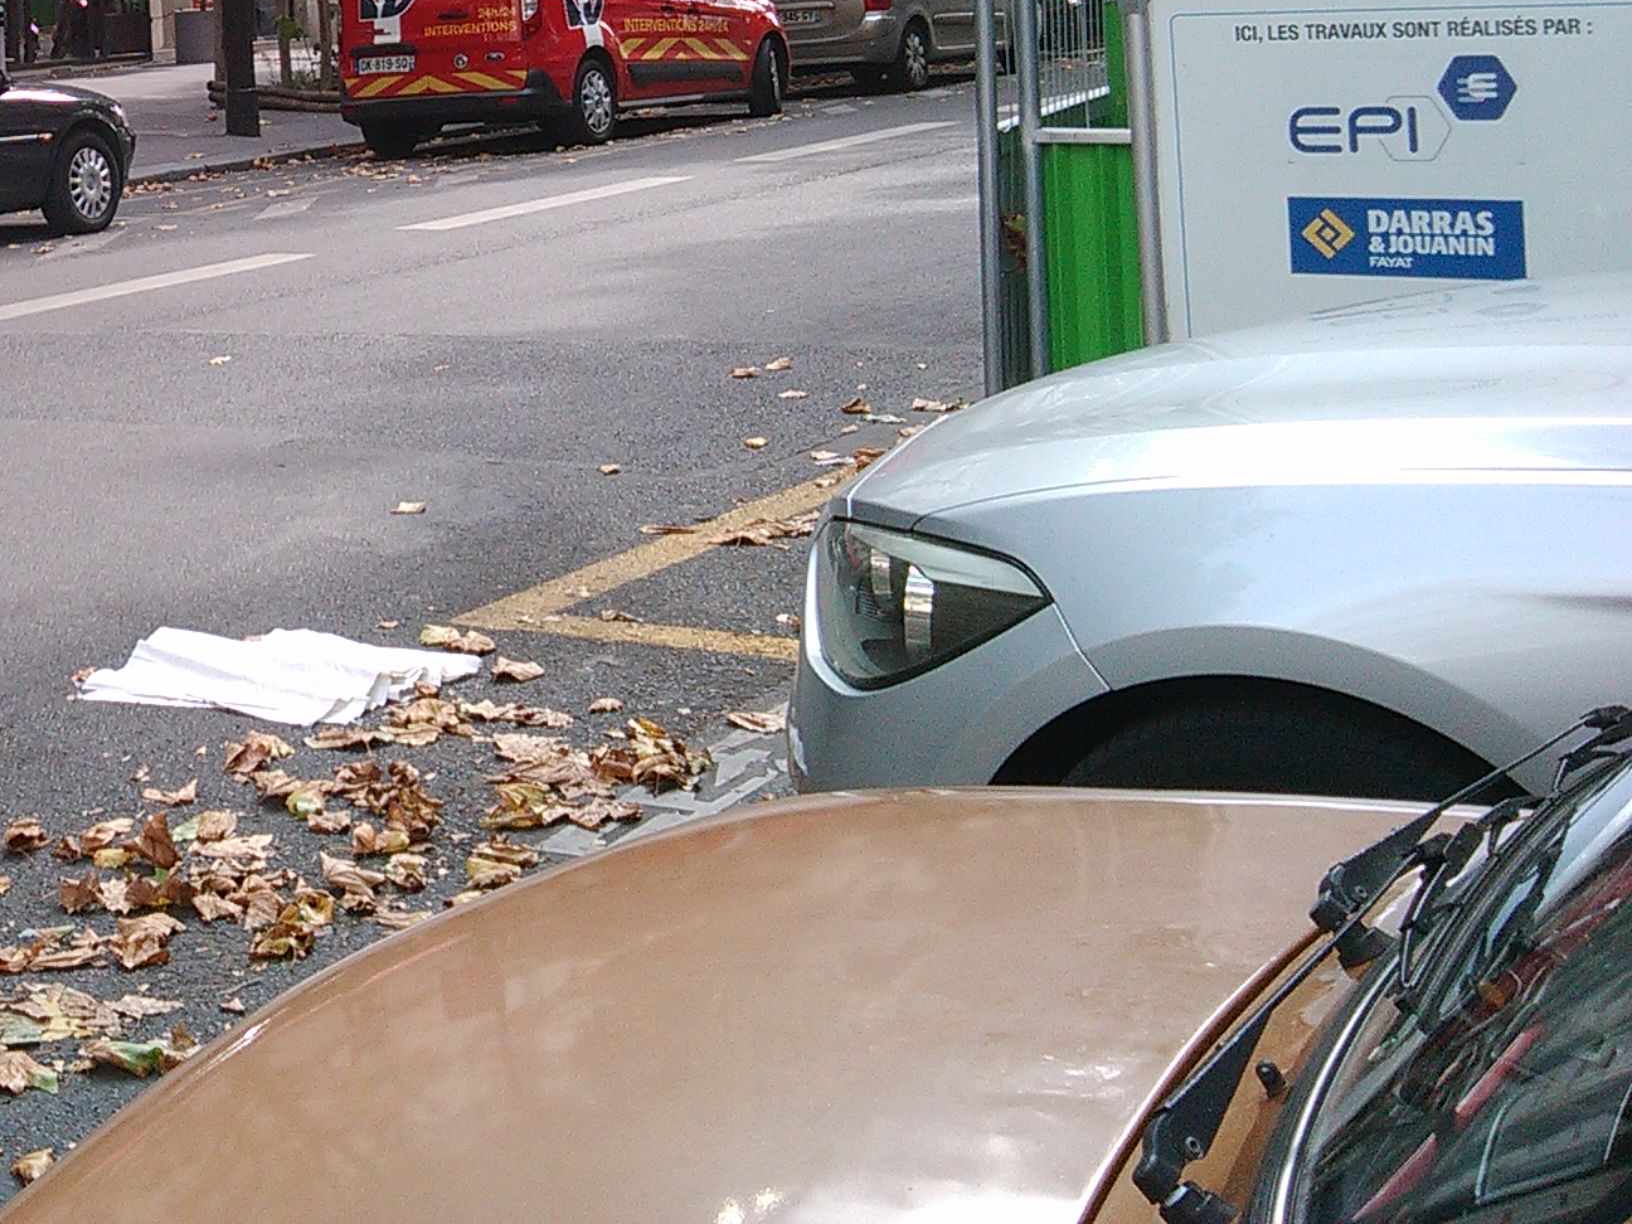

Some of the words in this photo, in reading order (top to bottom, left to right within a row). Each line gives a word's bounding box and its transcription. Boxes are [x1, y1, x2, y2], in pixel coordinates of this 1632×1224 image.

[424, 20, 517, 36] INTERVENTIONS
[623, 17, 696, 32] INTERVENTIONS
[1235, 24, 1263, 44] ICI,
[1268, 23, 1299, 41] LES
[1304, 21, 1387, 40] TRAVAUX
[1392, 21, 1441, 39] SONT
[1446, 15, 1538, 37] RÉALISÉS
[1542, 18, 1581, 35] PAR
[1289, 106, 1419, 154] EPI
[1367, 209, 1495, 236] DARRAS
[1388, 235, 1496, 256] JOUANIN
[1368, 256, 1415, 269] FAYAT
